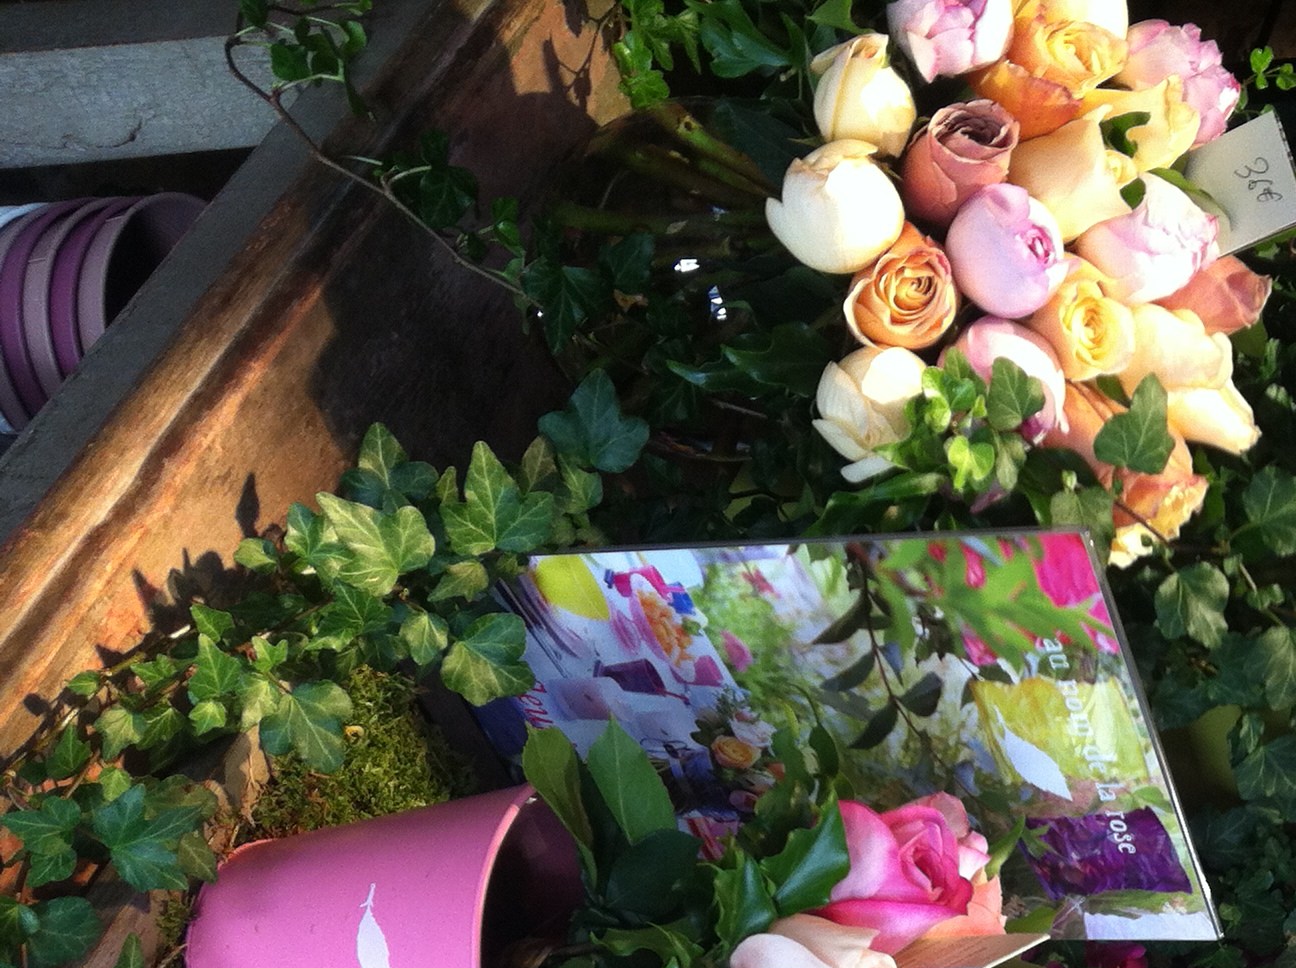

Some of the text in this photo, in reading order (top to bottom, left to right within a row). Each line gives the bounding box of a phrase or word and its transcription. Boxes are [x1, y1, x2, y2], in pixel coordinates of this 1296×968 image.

[1234, 157, 1284, 204] 36€
[1043, 638, 1138, 855] au nom de la rose
